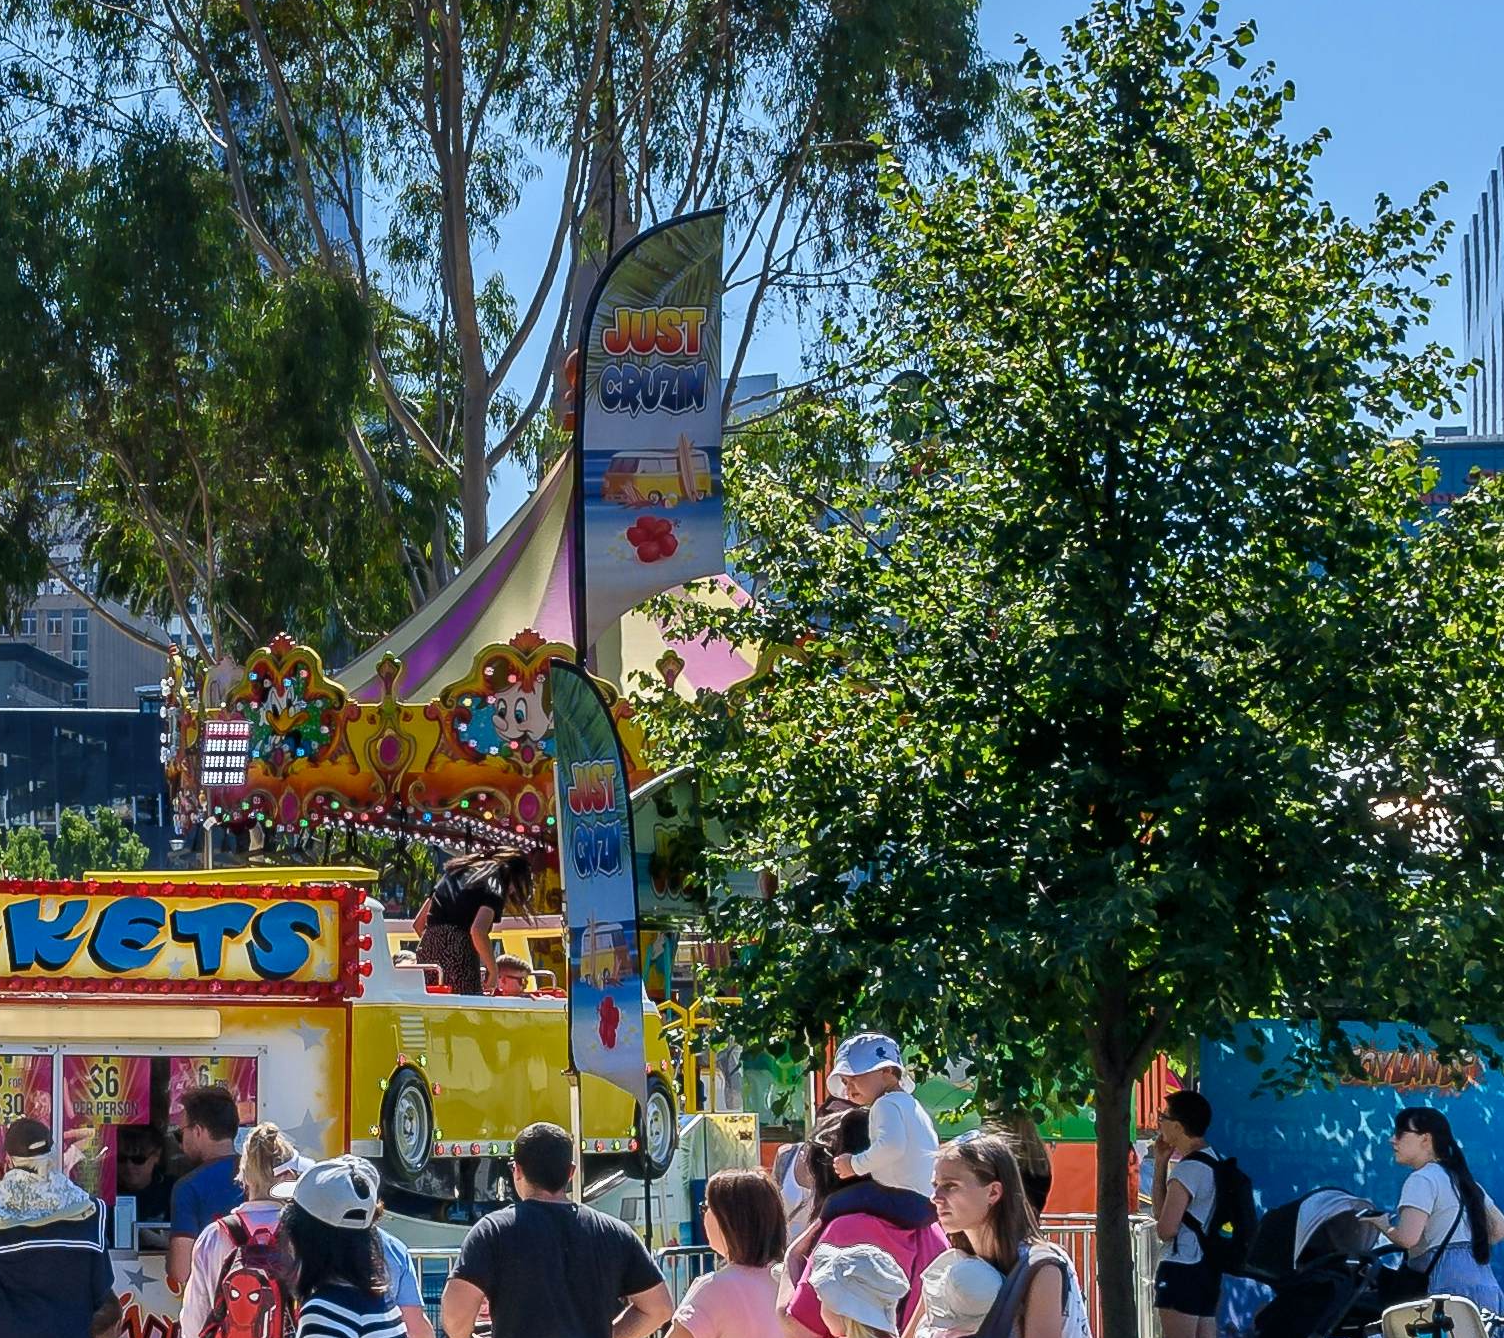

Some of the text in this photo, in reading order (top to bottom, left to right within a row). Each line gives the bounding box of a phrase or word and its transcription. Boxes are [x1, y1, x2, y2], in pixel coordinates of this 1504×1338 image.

[601, 306, 708, 357] JUST
[598, 361, 708, 416] CRUZIN
[568, 760, 617, 815] JUST
[8, 1077, 23, 1088] FOR
[90, 1064, 119, 1099] $6
[72, 1102, 138, 1117] PER PERSON
